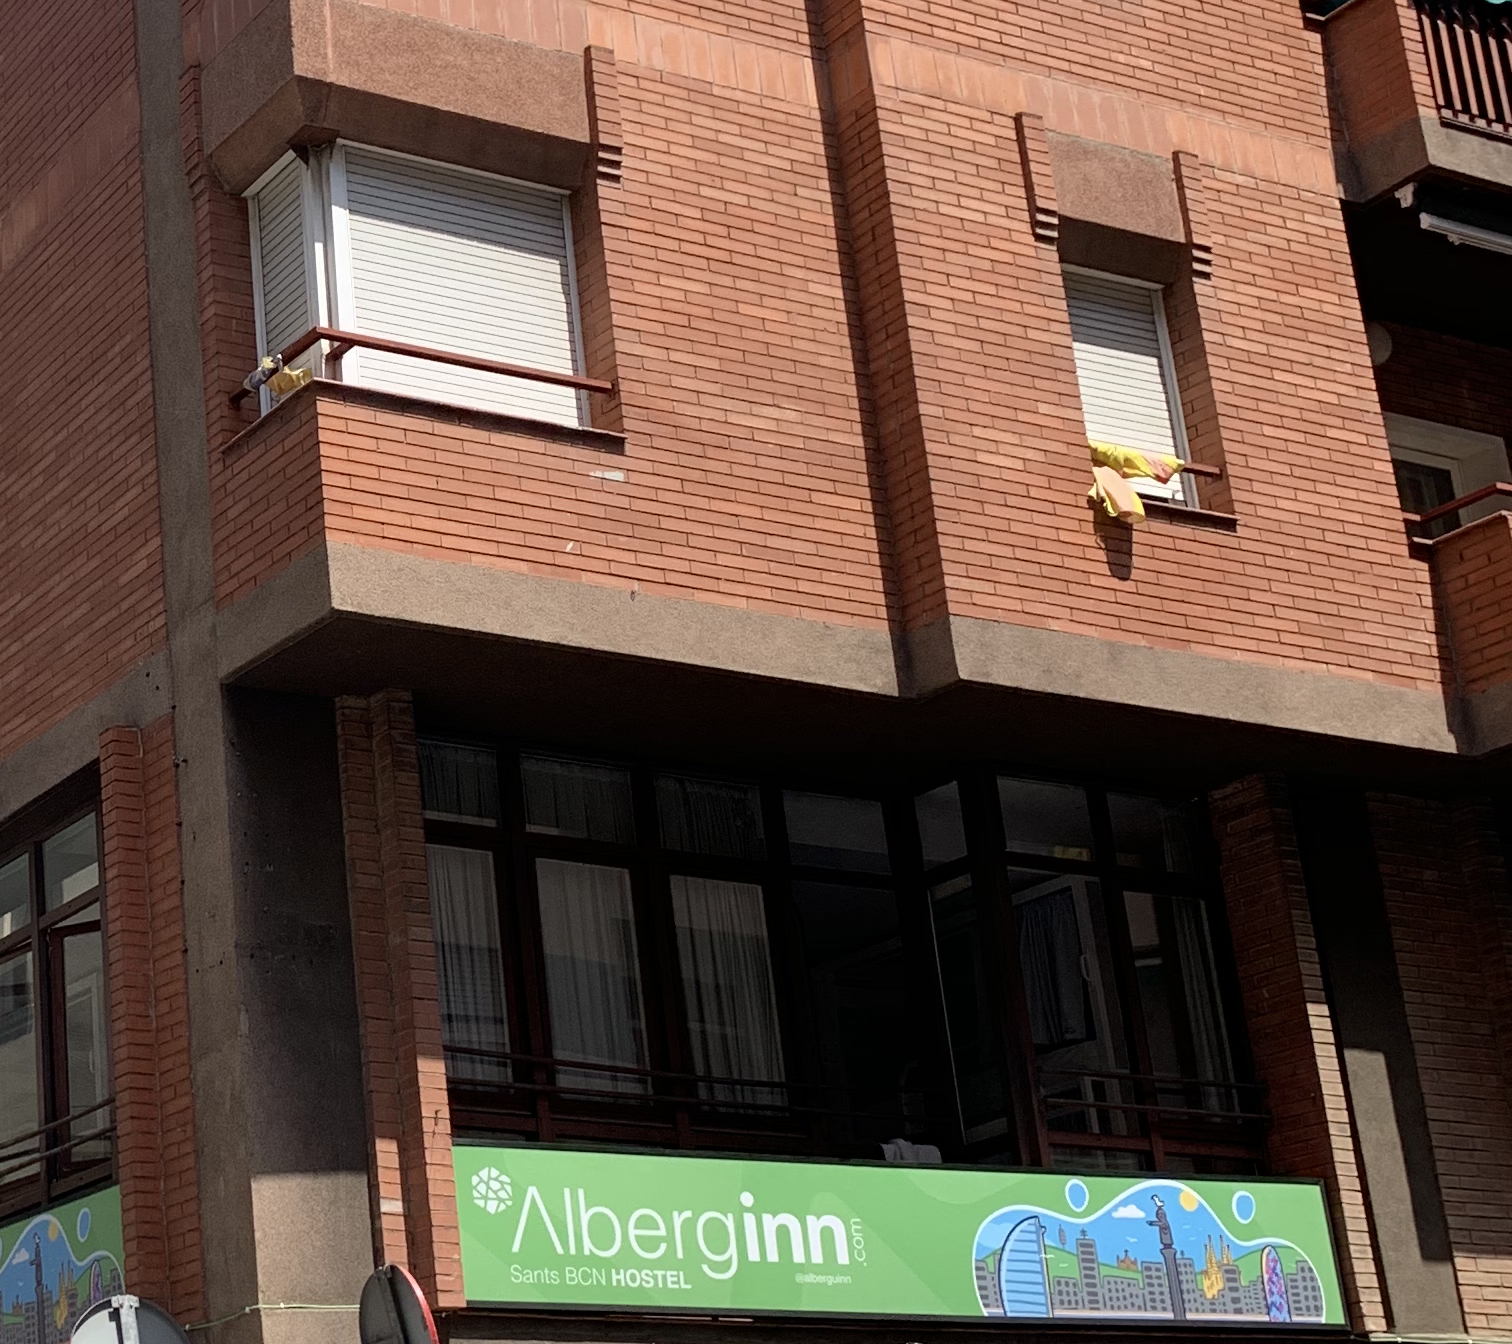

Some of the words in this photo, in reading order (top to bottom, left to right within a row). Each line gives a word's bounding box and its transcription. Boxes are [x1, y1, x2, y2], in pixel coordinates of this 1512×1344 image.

[511, 1185, 850, 1279] Alberginn
[850, 1218, 867, 1267] .com
[510, 1264, 560, 1284] Sants
[565, 1266, 607, 1286] BCN
[611, 1268, 693, 1289] HOSTEL
